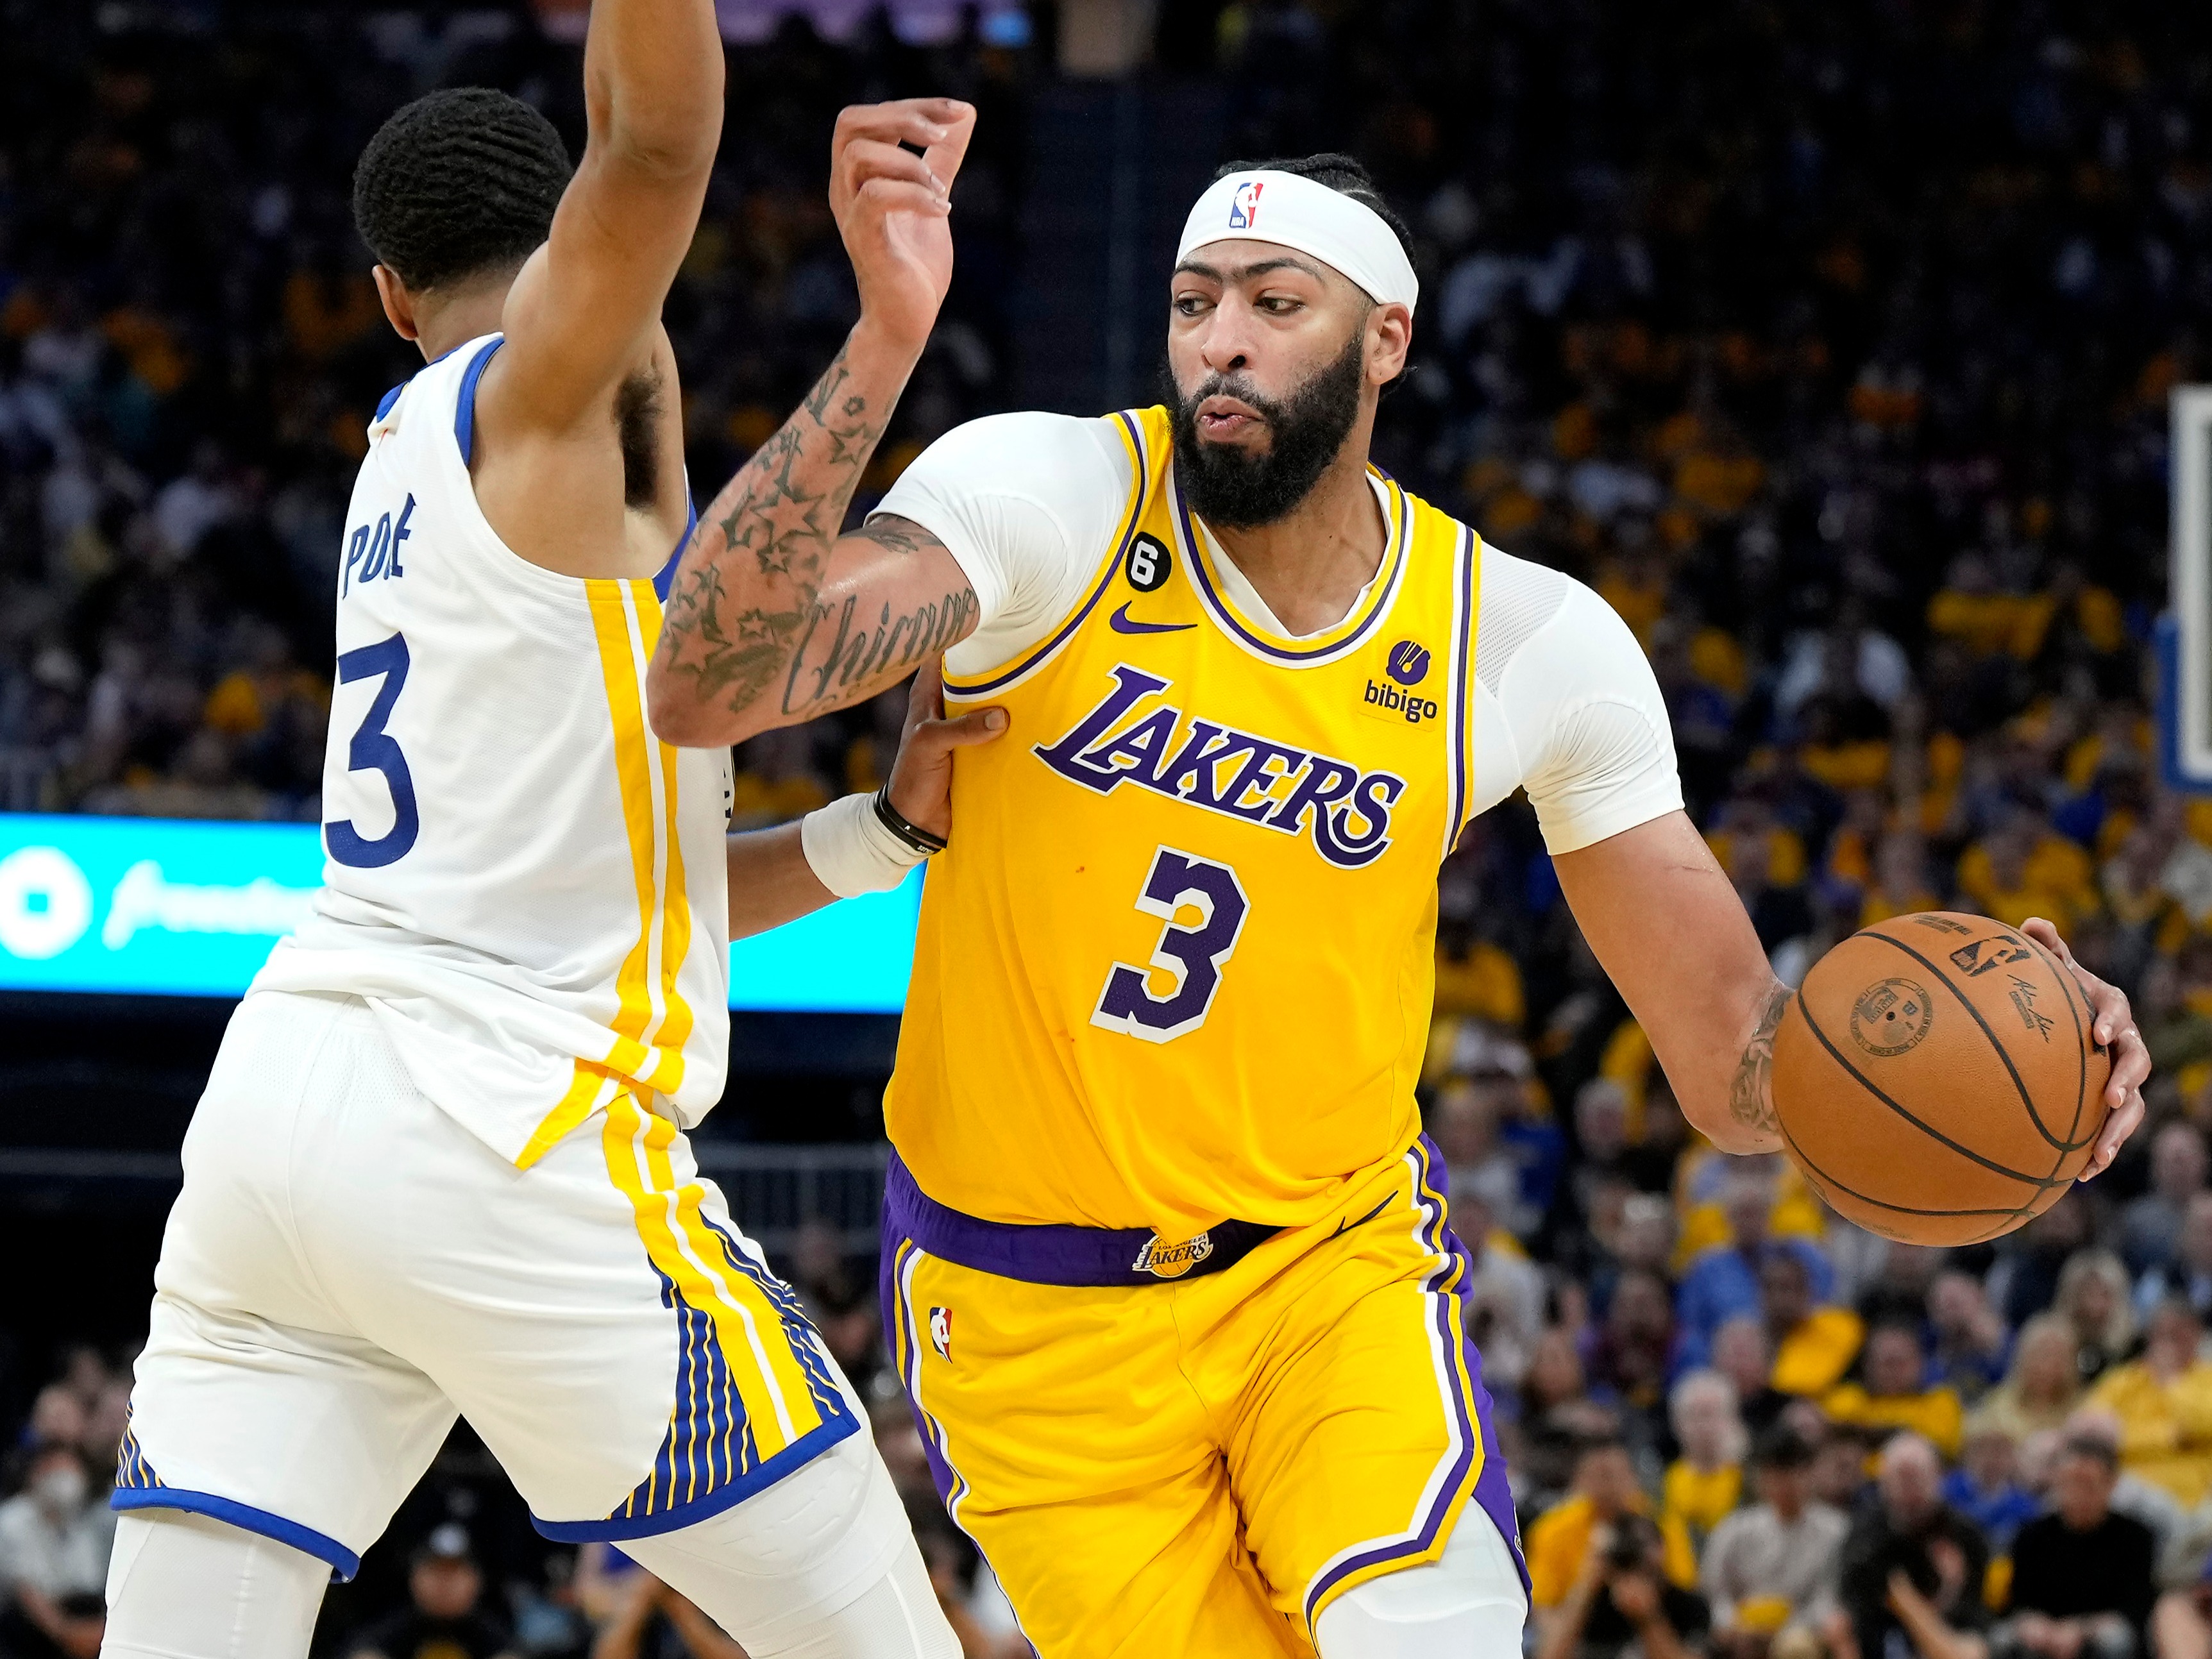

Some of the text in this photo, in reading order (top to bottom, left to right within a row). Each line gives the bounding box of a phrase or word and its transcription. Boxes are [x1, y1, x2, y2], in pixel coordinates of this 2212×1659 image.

[1231, 217, 1244, 226] NBA
[1130, 539, 1159, 585] 6
[1364, 679, 1437, 723] bibigo
[325, 631, 419, 868] 3
[1030, 662, 1407, 870] LAKERS
[1089, 844, 1251, 1045] 3
[1133, 1242, 1210, 1269] LAKERS
